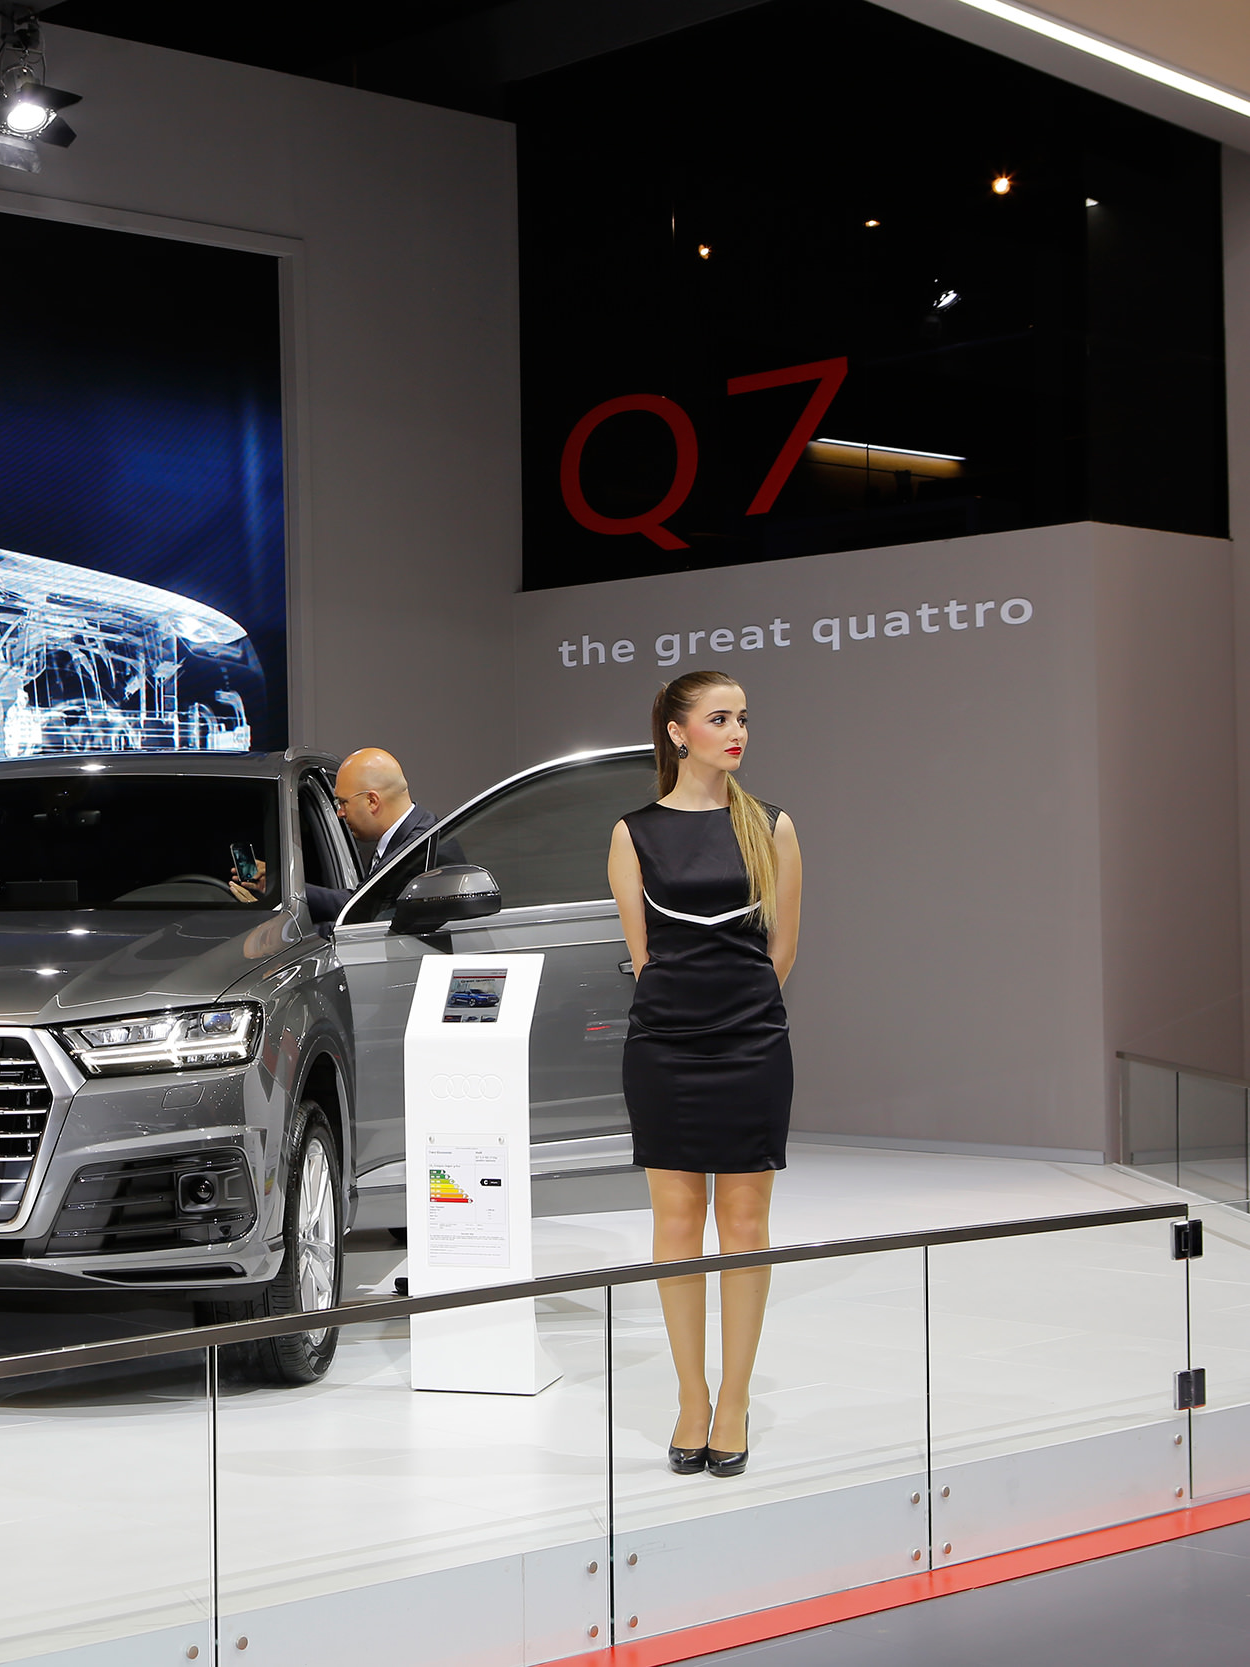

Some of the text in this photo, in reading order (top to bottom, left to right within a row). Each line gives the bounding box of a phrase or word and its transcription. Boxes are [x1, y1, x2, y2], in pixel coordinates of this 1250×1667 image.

[560, 356, 848, 550] Q7
[558, 597, 1033, 667] the great quattro
